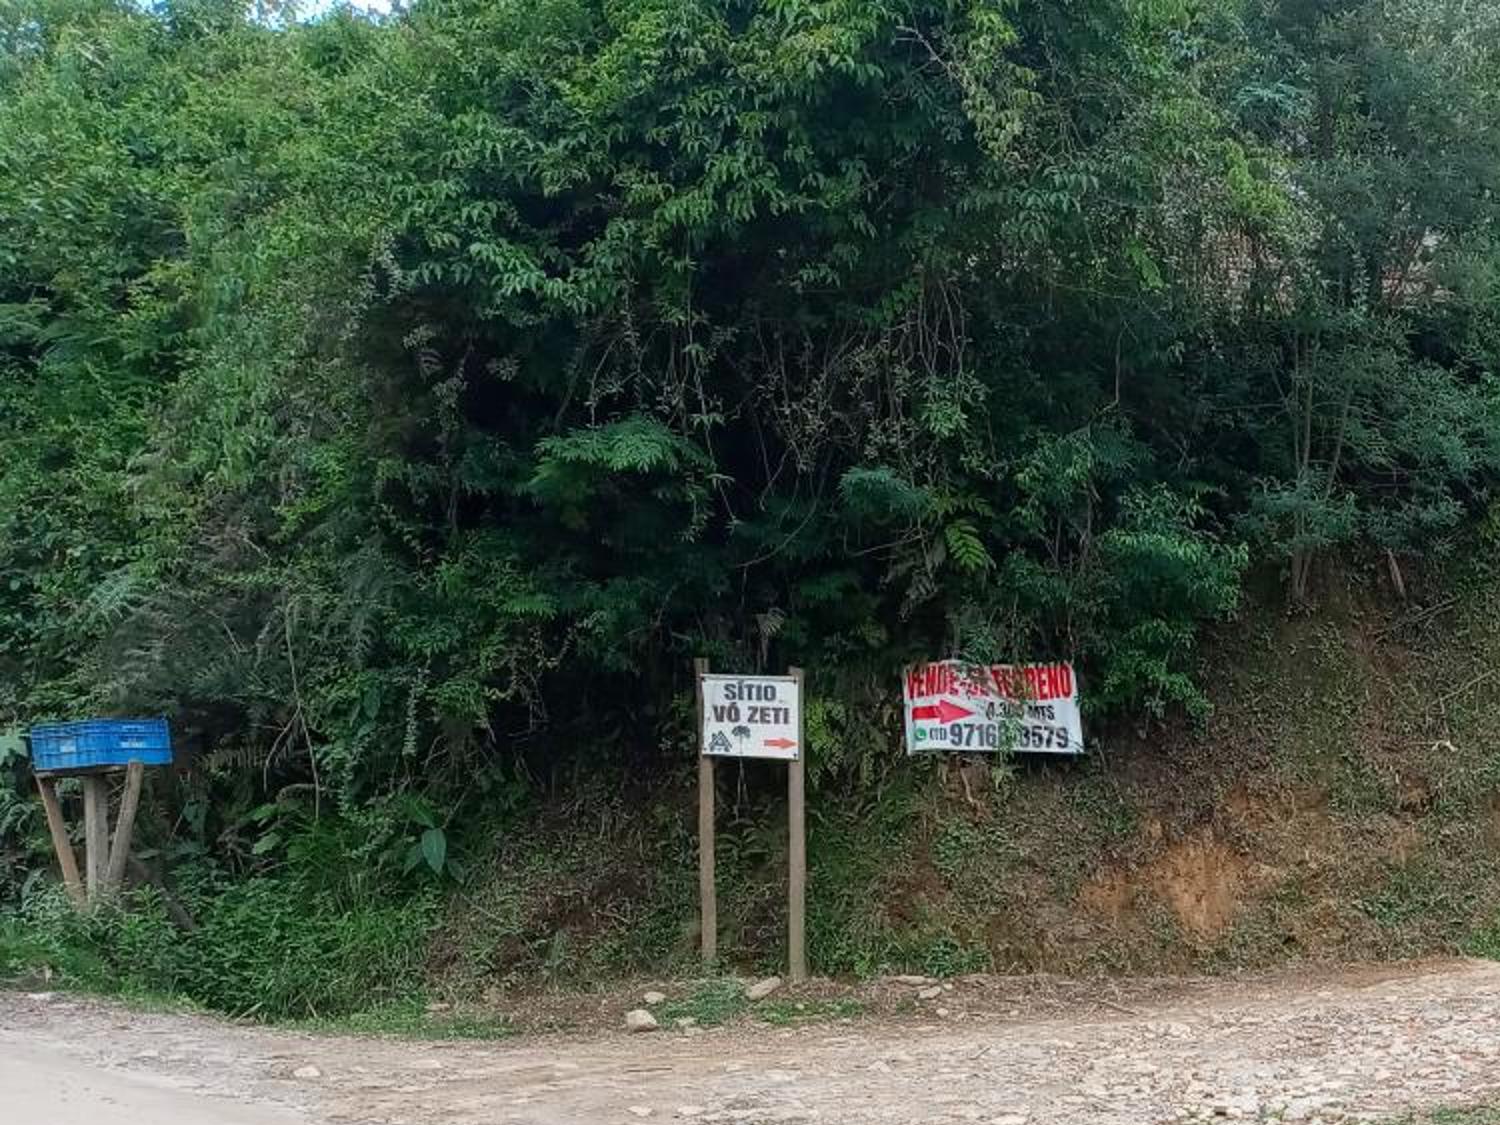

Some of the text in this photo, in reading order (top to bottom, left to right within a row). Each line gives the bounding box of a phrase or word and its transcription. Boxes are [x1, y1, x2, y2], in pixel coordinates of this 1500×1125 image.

[724, 680, 777, 701] SÍTIO
[747, 705, 790, 724] ZETI
[1027, 704, 1056, 722] MTS
